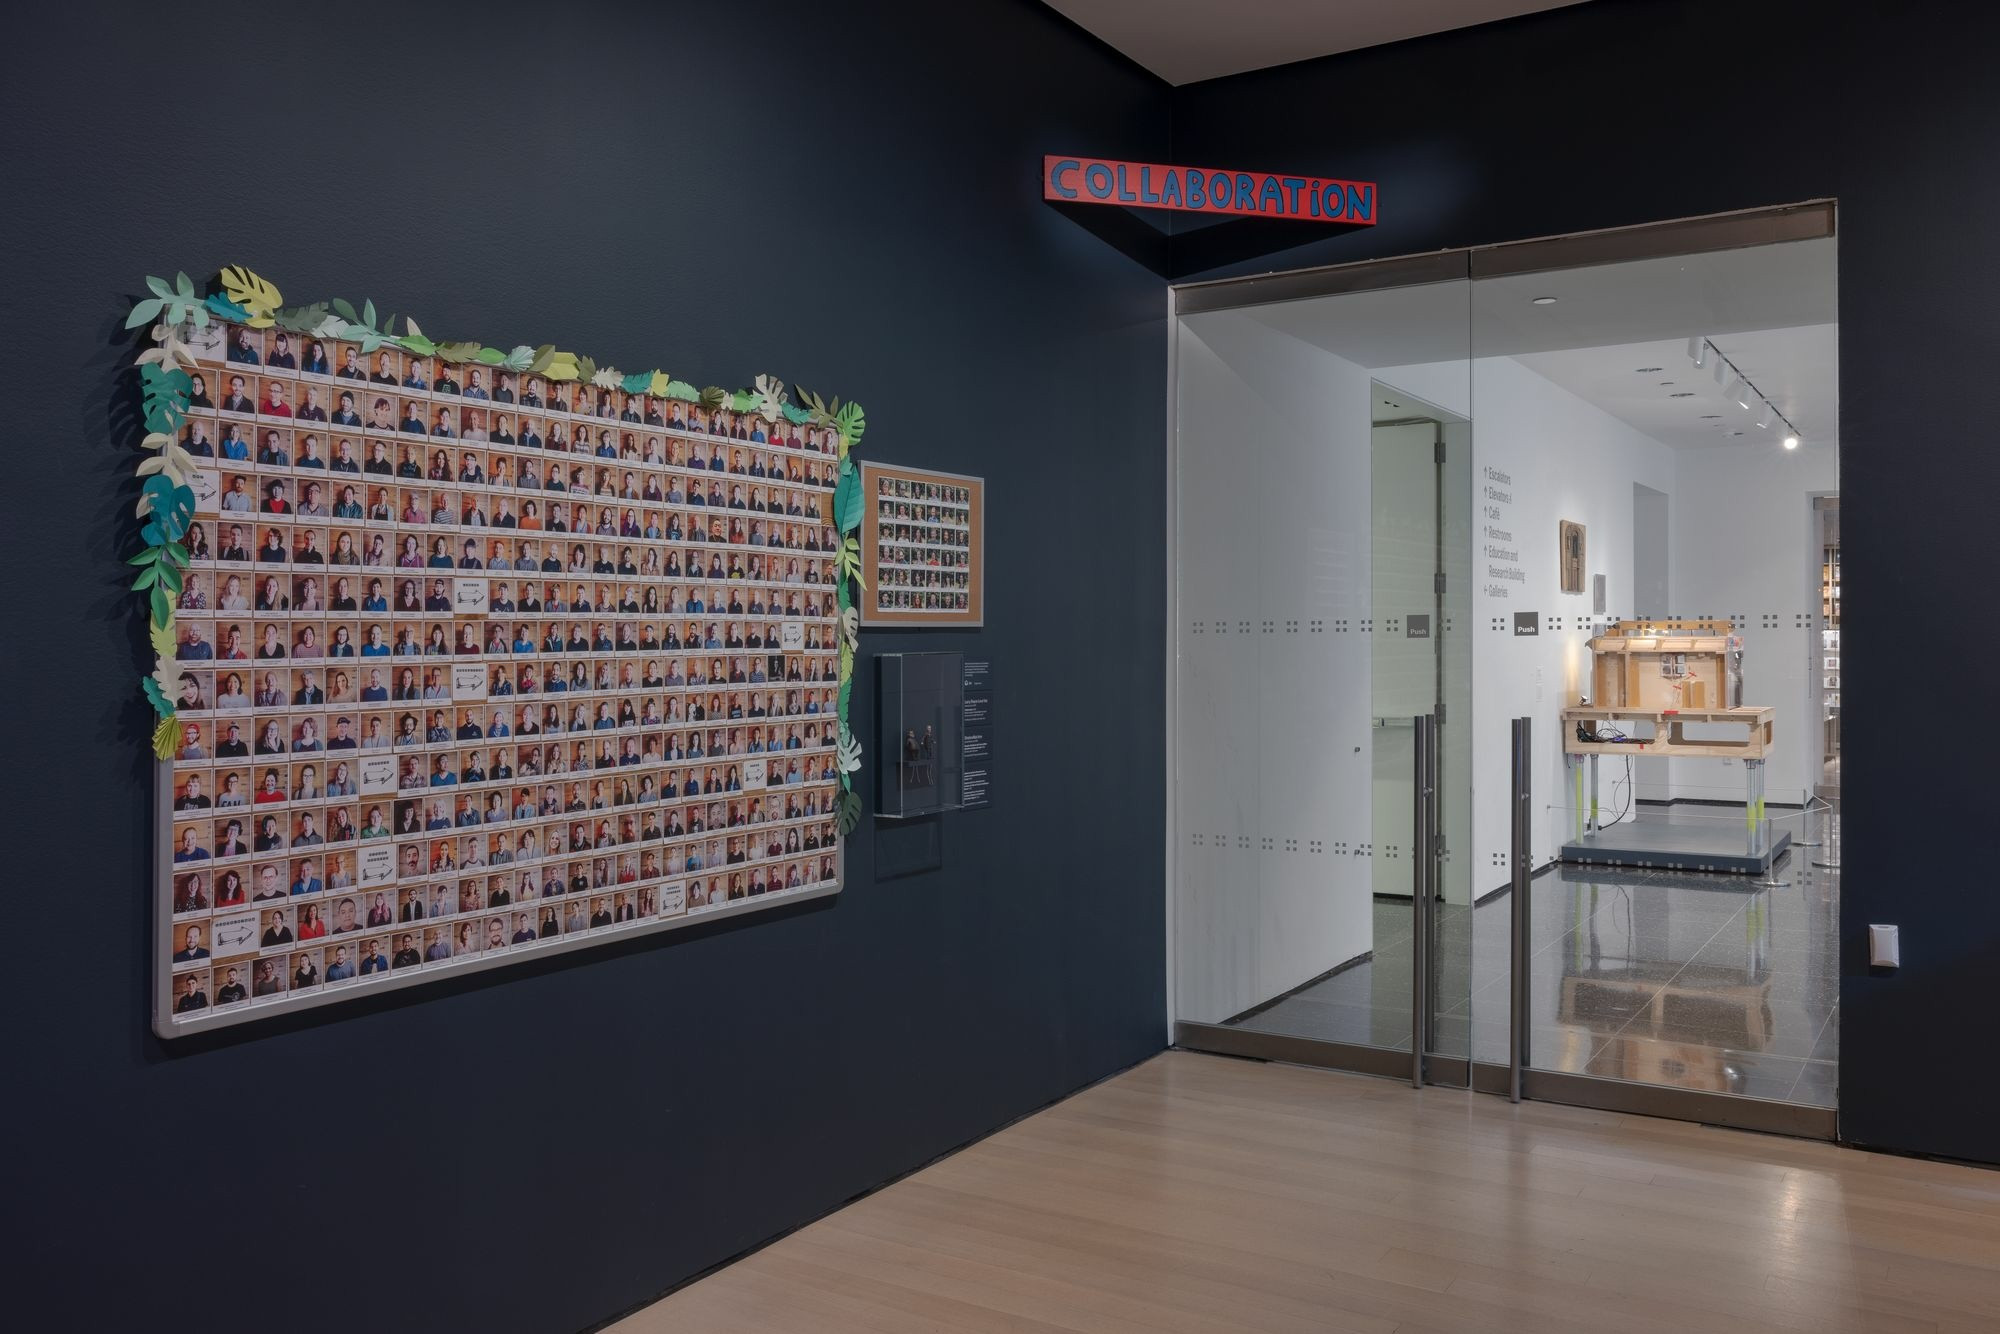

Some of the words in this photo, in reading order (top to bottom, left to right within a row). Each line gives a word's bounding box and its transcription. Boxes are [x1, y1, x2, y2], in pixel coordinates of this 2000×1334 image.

[1488, 467, 1511, 486] Escalators
[1488, 487, 1508, 504] Elevators
[1488, 526, 1512, 542] Restrooms
[1488, 545, 1510, 560] Education
[1510, 550, 1519, 562] and
[1488, 565, 1508, 579] Research
[1509, 568, 1525, 584] Building
[1488, 584, 1508, 598] Galleries
